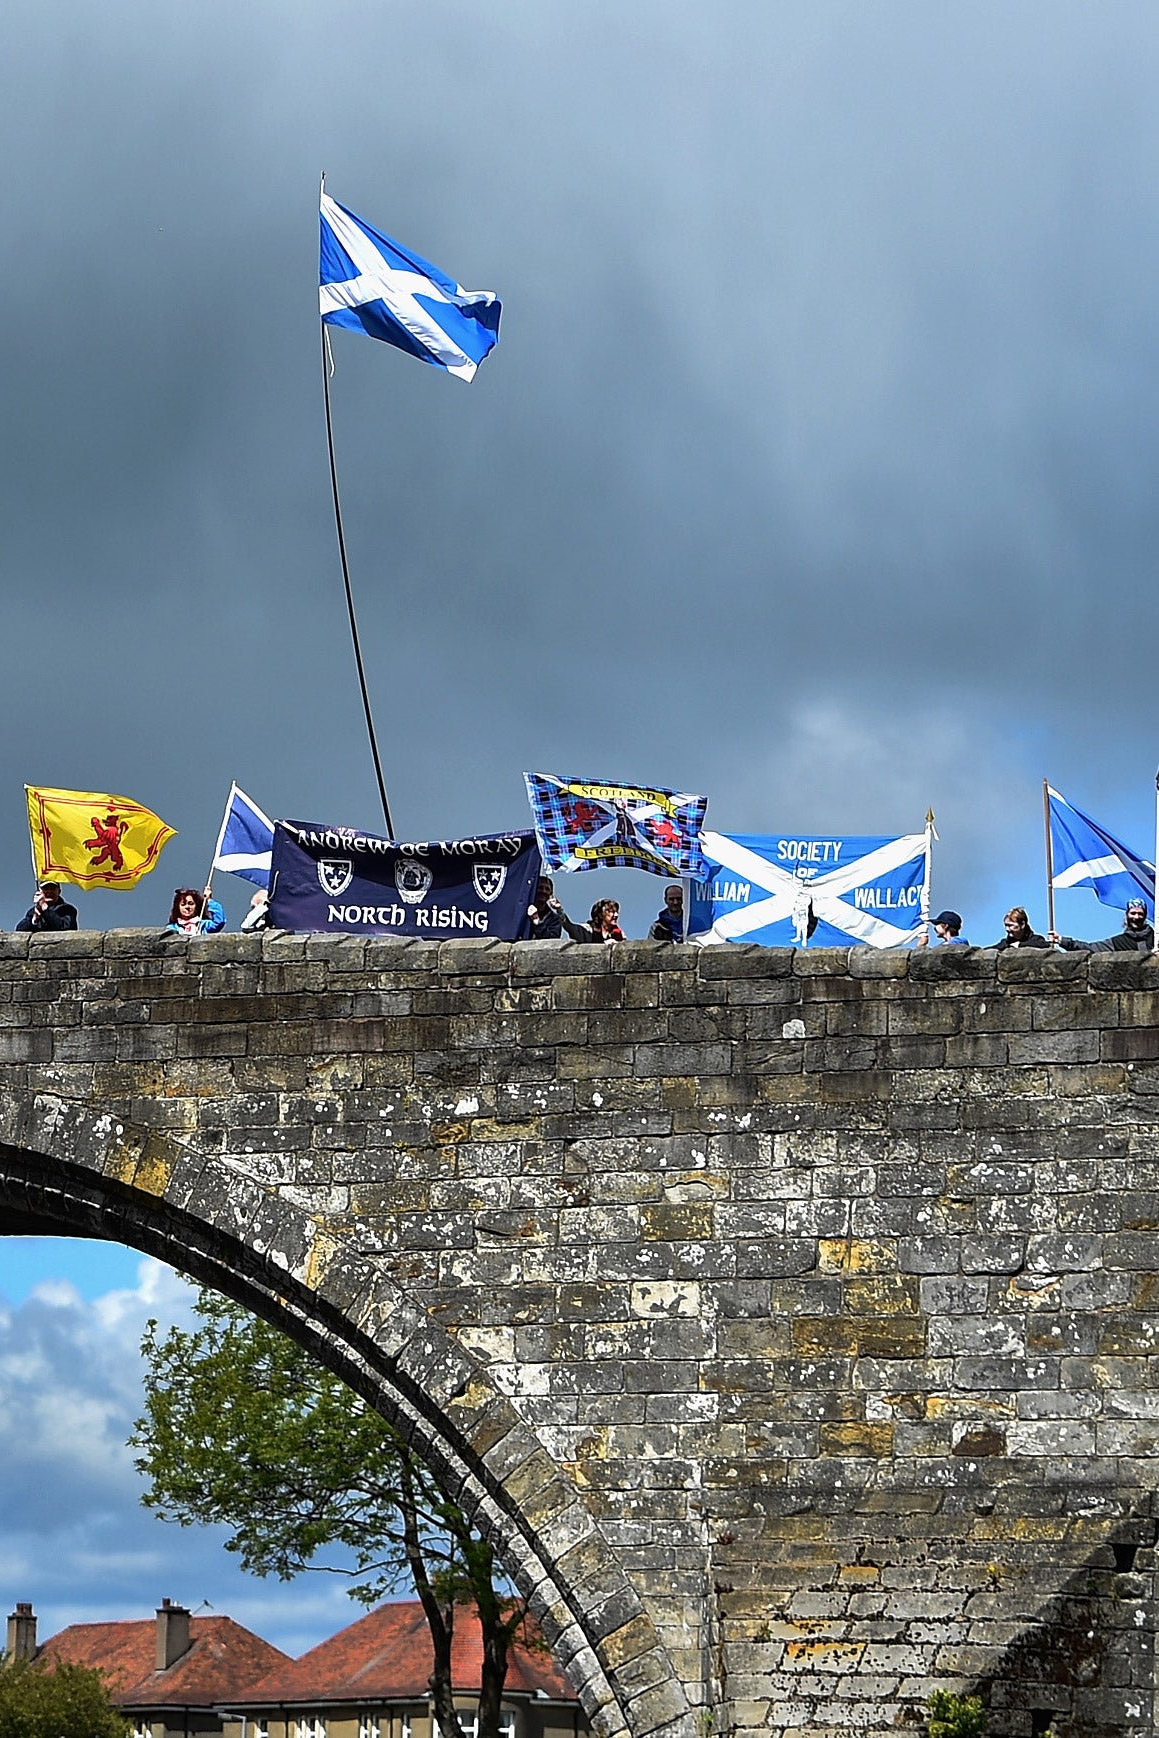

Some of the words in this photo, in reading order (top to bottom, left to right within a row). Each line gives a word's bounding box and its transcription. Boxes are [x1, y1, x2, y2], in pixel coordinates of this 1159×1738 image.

[581, 786, 656, 801] SCOTLAND
[297, 826, 389, 855] ANDREW
[440, 837, 522, 857] MORAY
[777, 840, 843, 862] SOCIETY
[797, 867, 818, 878] OF
[695, 881, 751, 903] WILLIAM
[327, 903, 406, 926] NORTH
[416, 905, 489, 932] RISING
